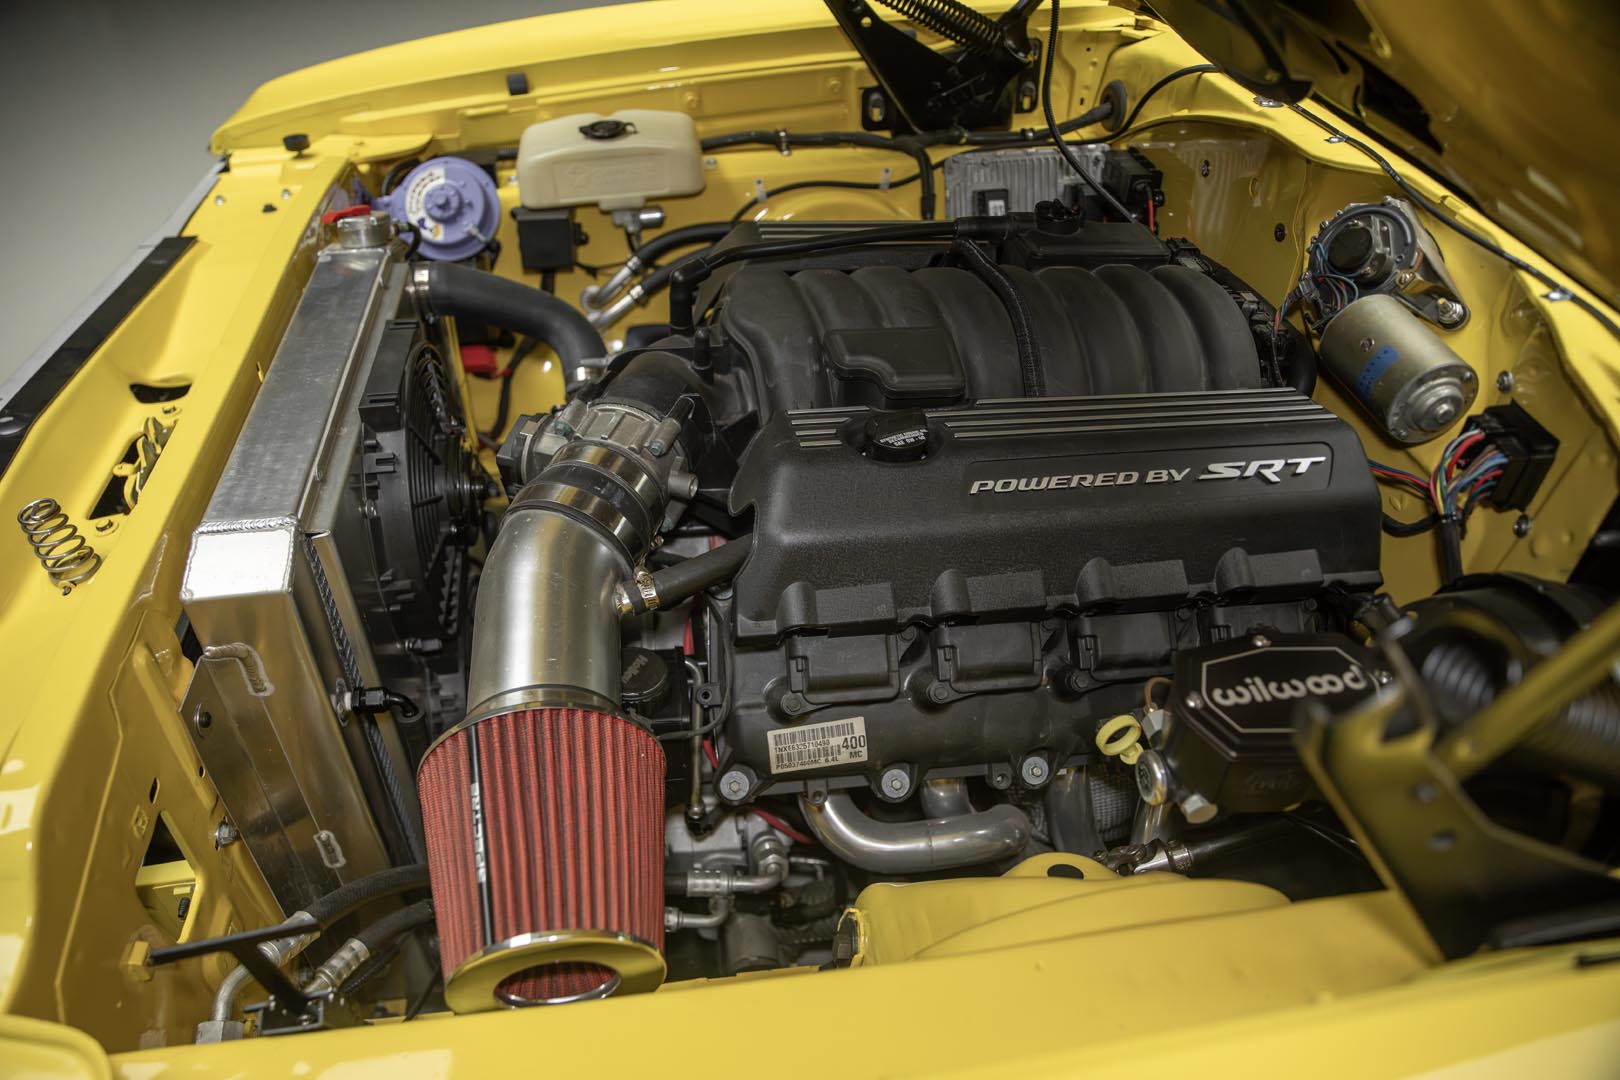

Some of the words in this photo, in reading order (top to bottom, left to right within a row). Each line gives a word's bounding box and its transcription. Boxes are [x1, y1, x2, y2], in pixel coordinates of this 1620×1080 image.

[969, 470, 1140, 495] POWERED
[1145, 467, 1192, 485] BY
[1197, 456, 1327, 484] SRT
[1212, 664, 1368, 707] wilwood
[841, 734, 866, 751] 400
[849, 750, 863, 760] MC
